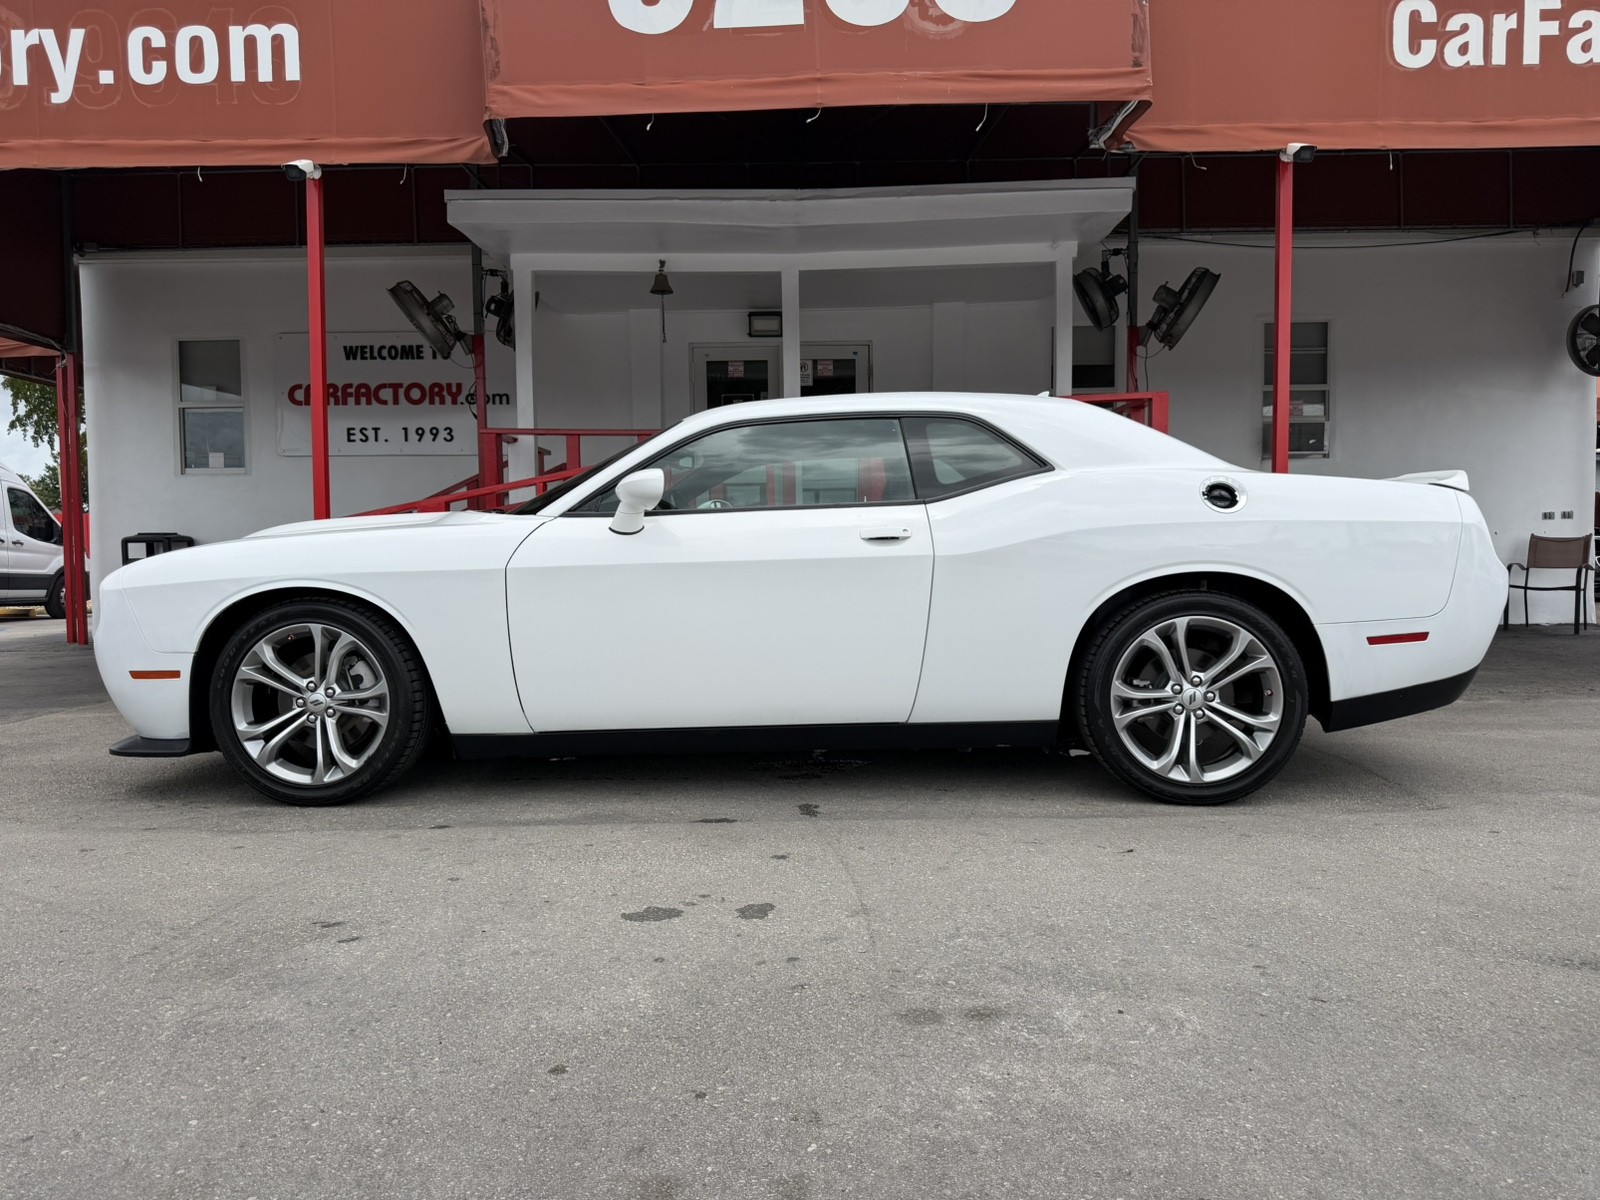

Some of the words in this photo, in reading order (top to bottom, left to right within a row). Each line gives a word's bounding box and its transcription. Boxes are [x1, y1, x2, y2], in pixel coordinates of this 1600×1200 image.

[1393, 0, 1600, 69] CarFa
[0, 23, 301, 104] ry.com
[343, 345, 424, 360] WELCOME
[346, 427, 389, 443] EST.
[402, 427, 455, 443] 1993
